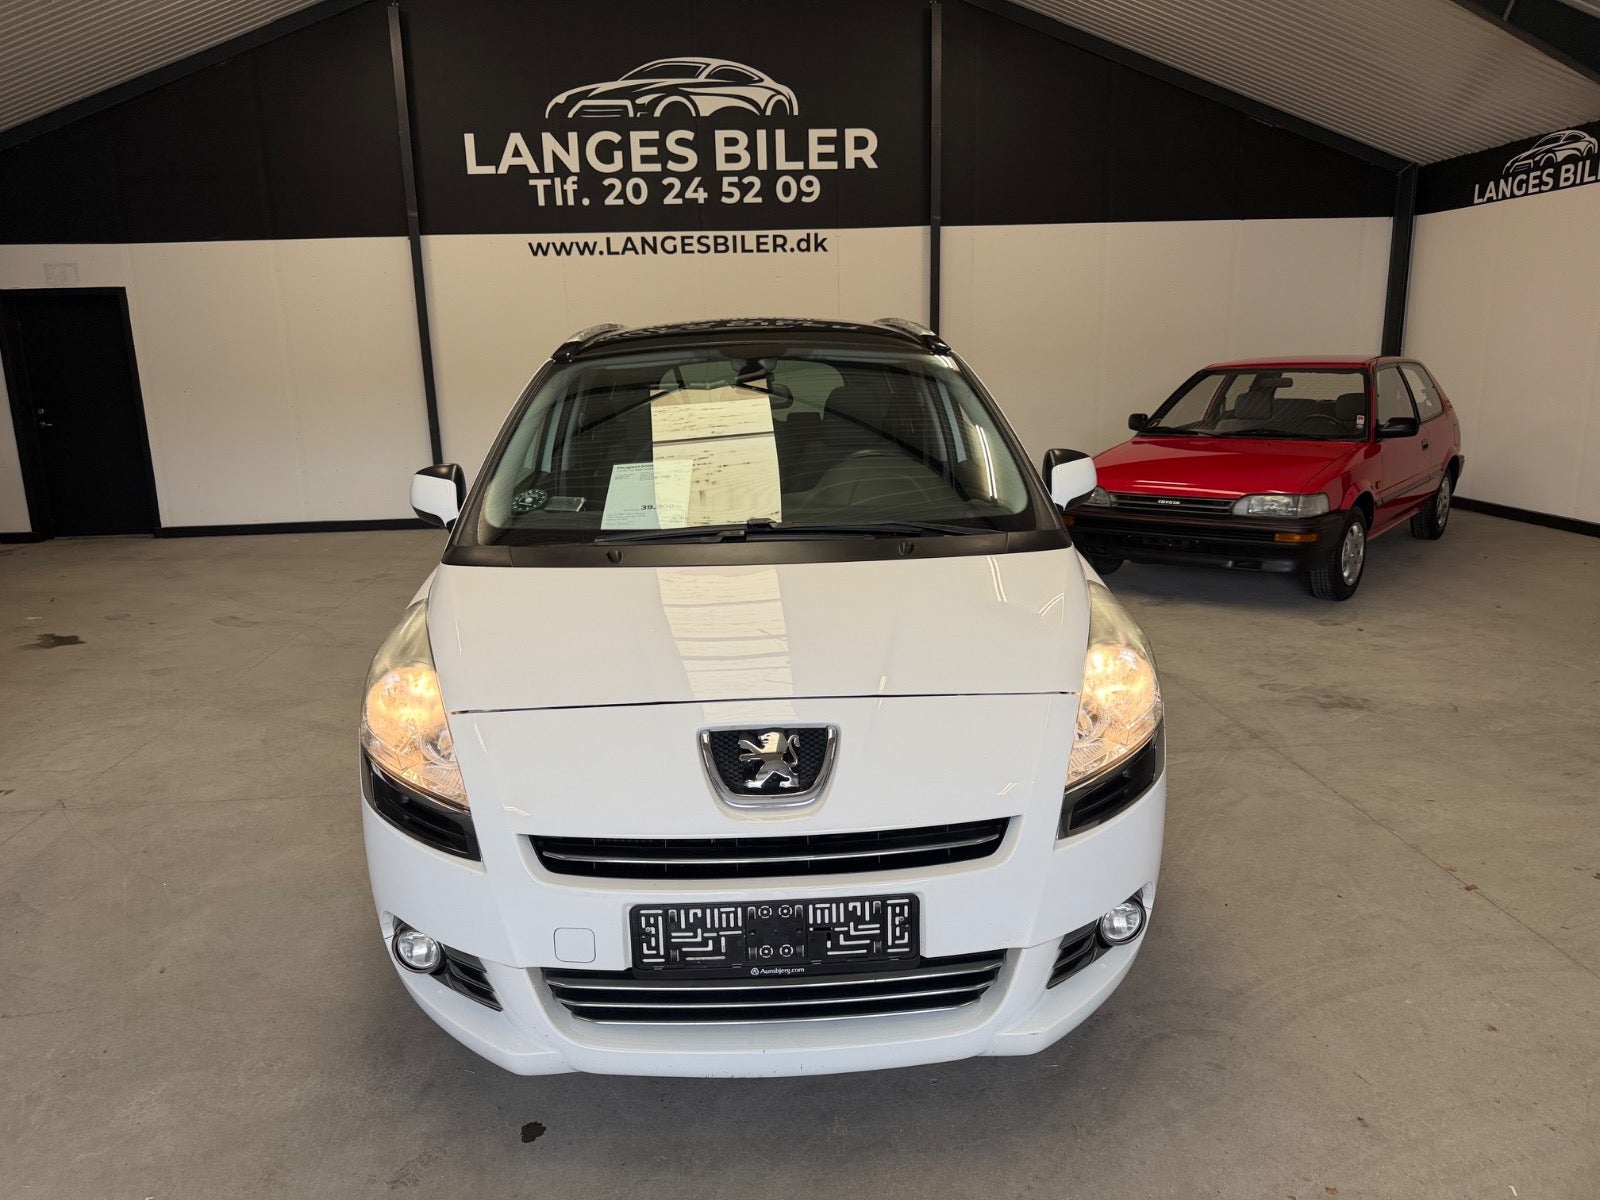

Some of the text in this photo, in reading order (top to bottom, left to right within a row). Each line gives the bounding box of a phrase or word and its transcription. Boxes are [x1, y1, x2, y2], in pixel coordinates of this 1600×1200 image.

[463, 127, 879, 175] LANGES BILER
[529, 174, 821, 206] Tlf. 20 24 52 09
[1473, 159, 1600, 204] LANGES BIL
[528, 232, 828, 257] www.LANGESBILER.dk
